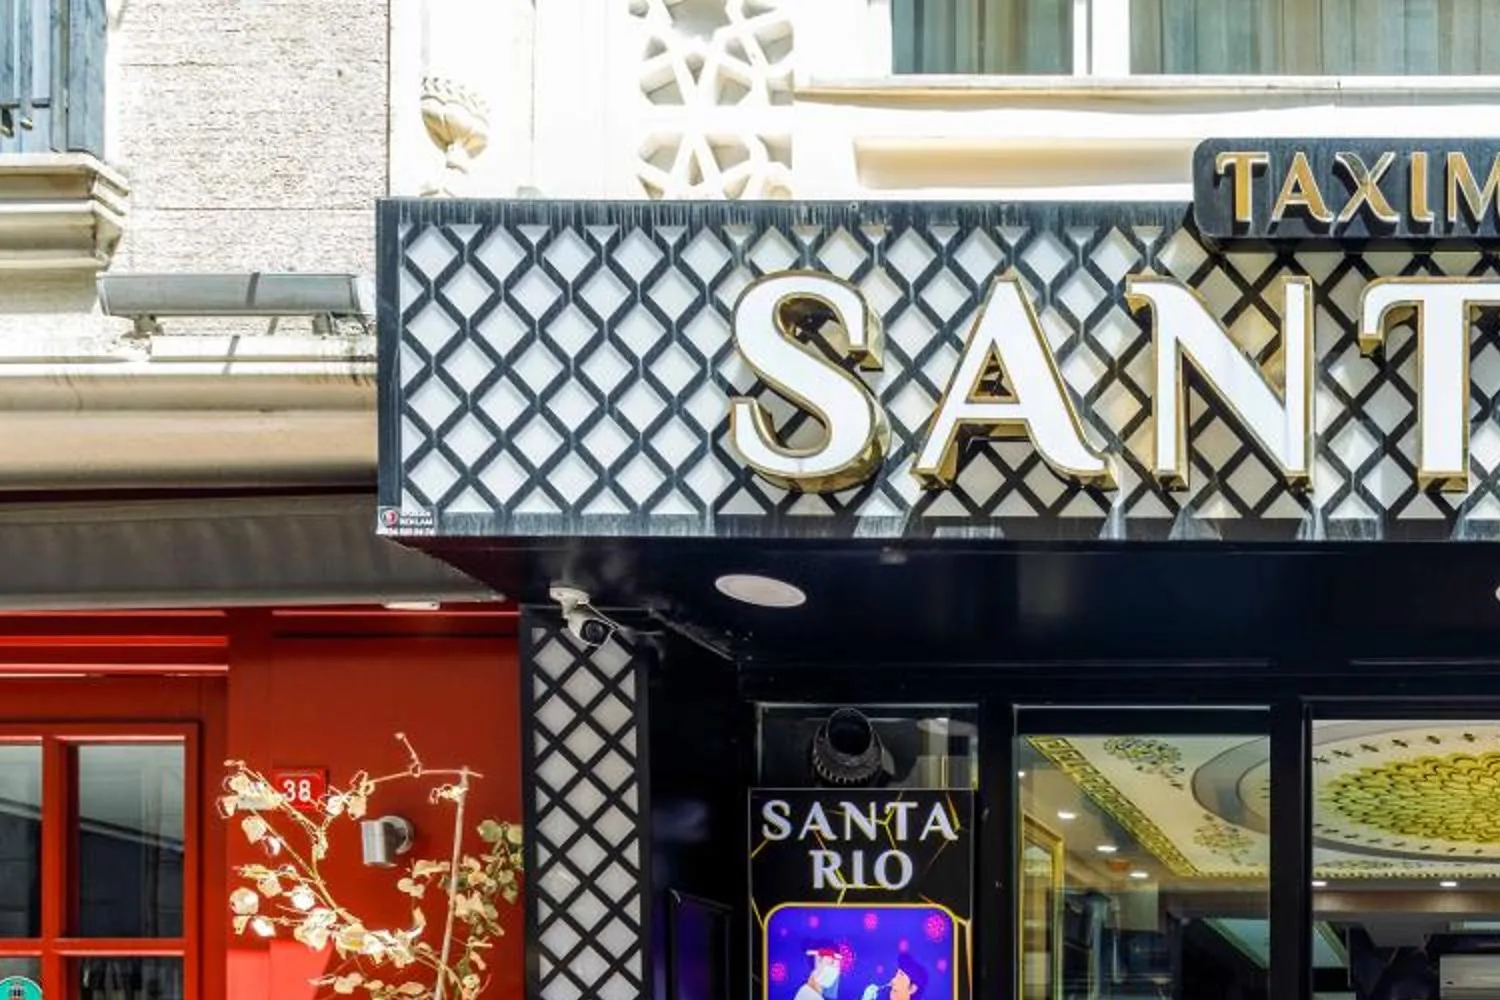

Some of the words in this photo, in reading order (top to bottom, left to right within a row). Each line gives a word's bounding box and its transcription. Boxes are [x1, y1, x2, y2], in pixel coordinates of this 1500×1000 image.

[283, 779, 312, 802] 38
[760, 799, 960, 841] SANTA
[808, 849, 914, 891] RIO
